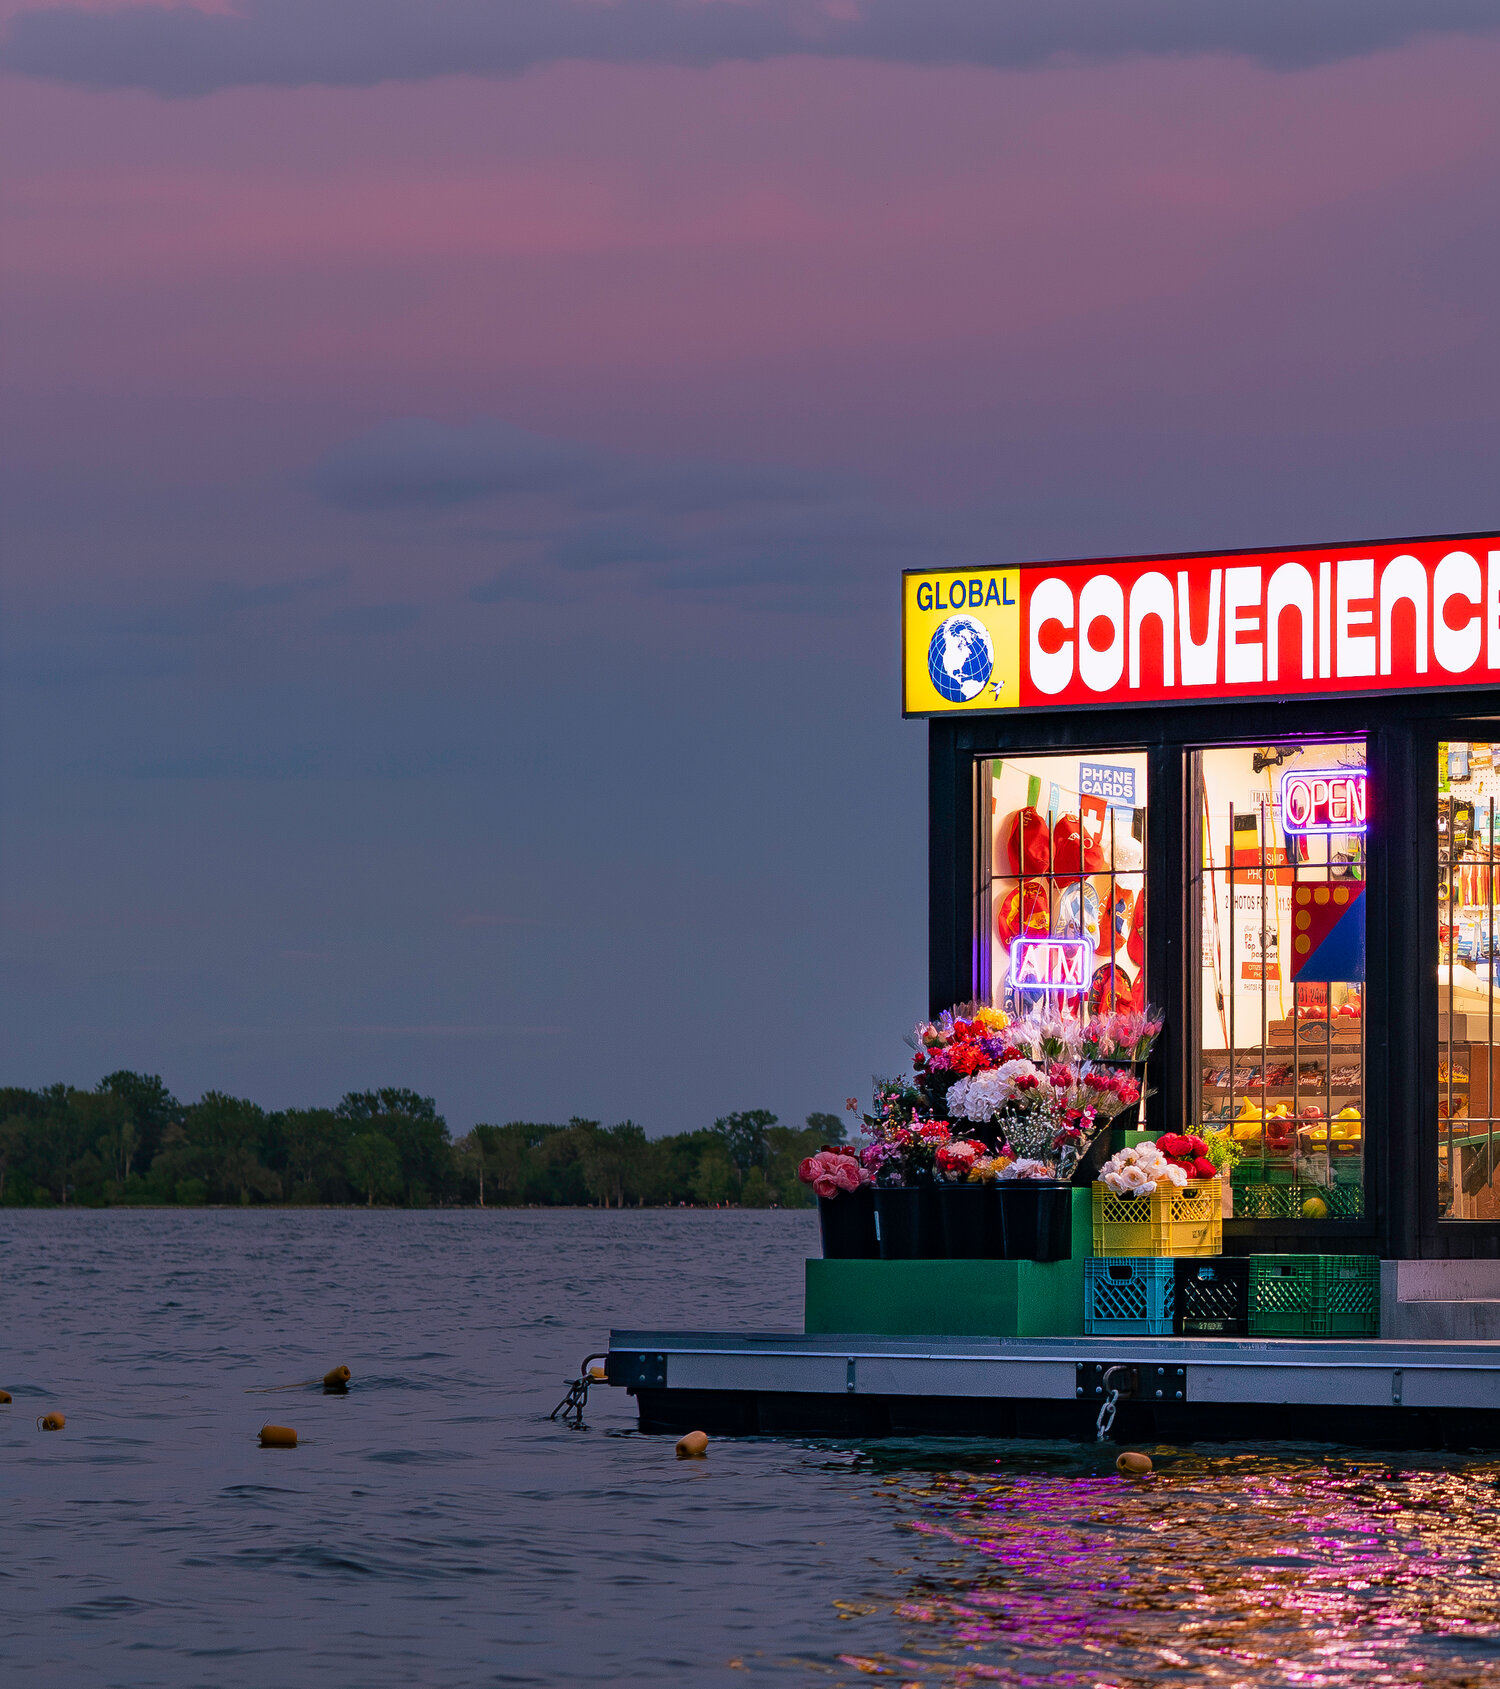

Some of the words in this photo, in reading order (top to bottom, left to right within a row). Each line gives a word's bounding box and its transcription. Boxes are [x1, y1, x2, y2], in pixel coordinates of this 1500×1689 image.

[917, 577, 1015, 611] GLOBAL
[1081, 780, 1133, 798] CARDS
[1082, 767, 1132, 785] PHONE
[1286, 777, 1366, 825] OPEN
[1233, 895, 1255, 909] HOTOS
[1018, 944, 1083, 983] ATM
